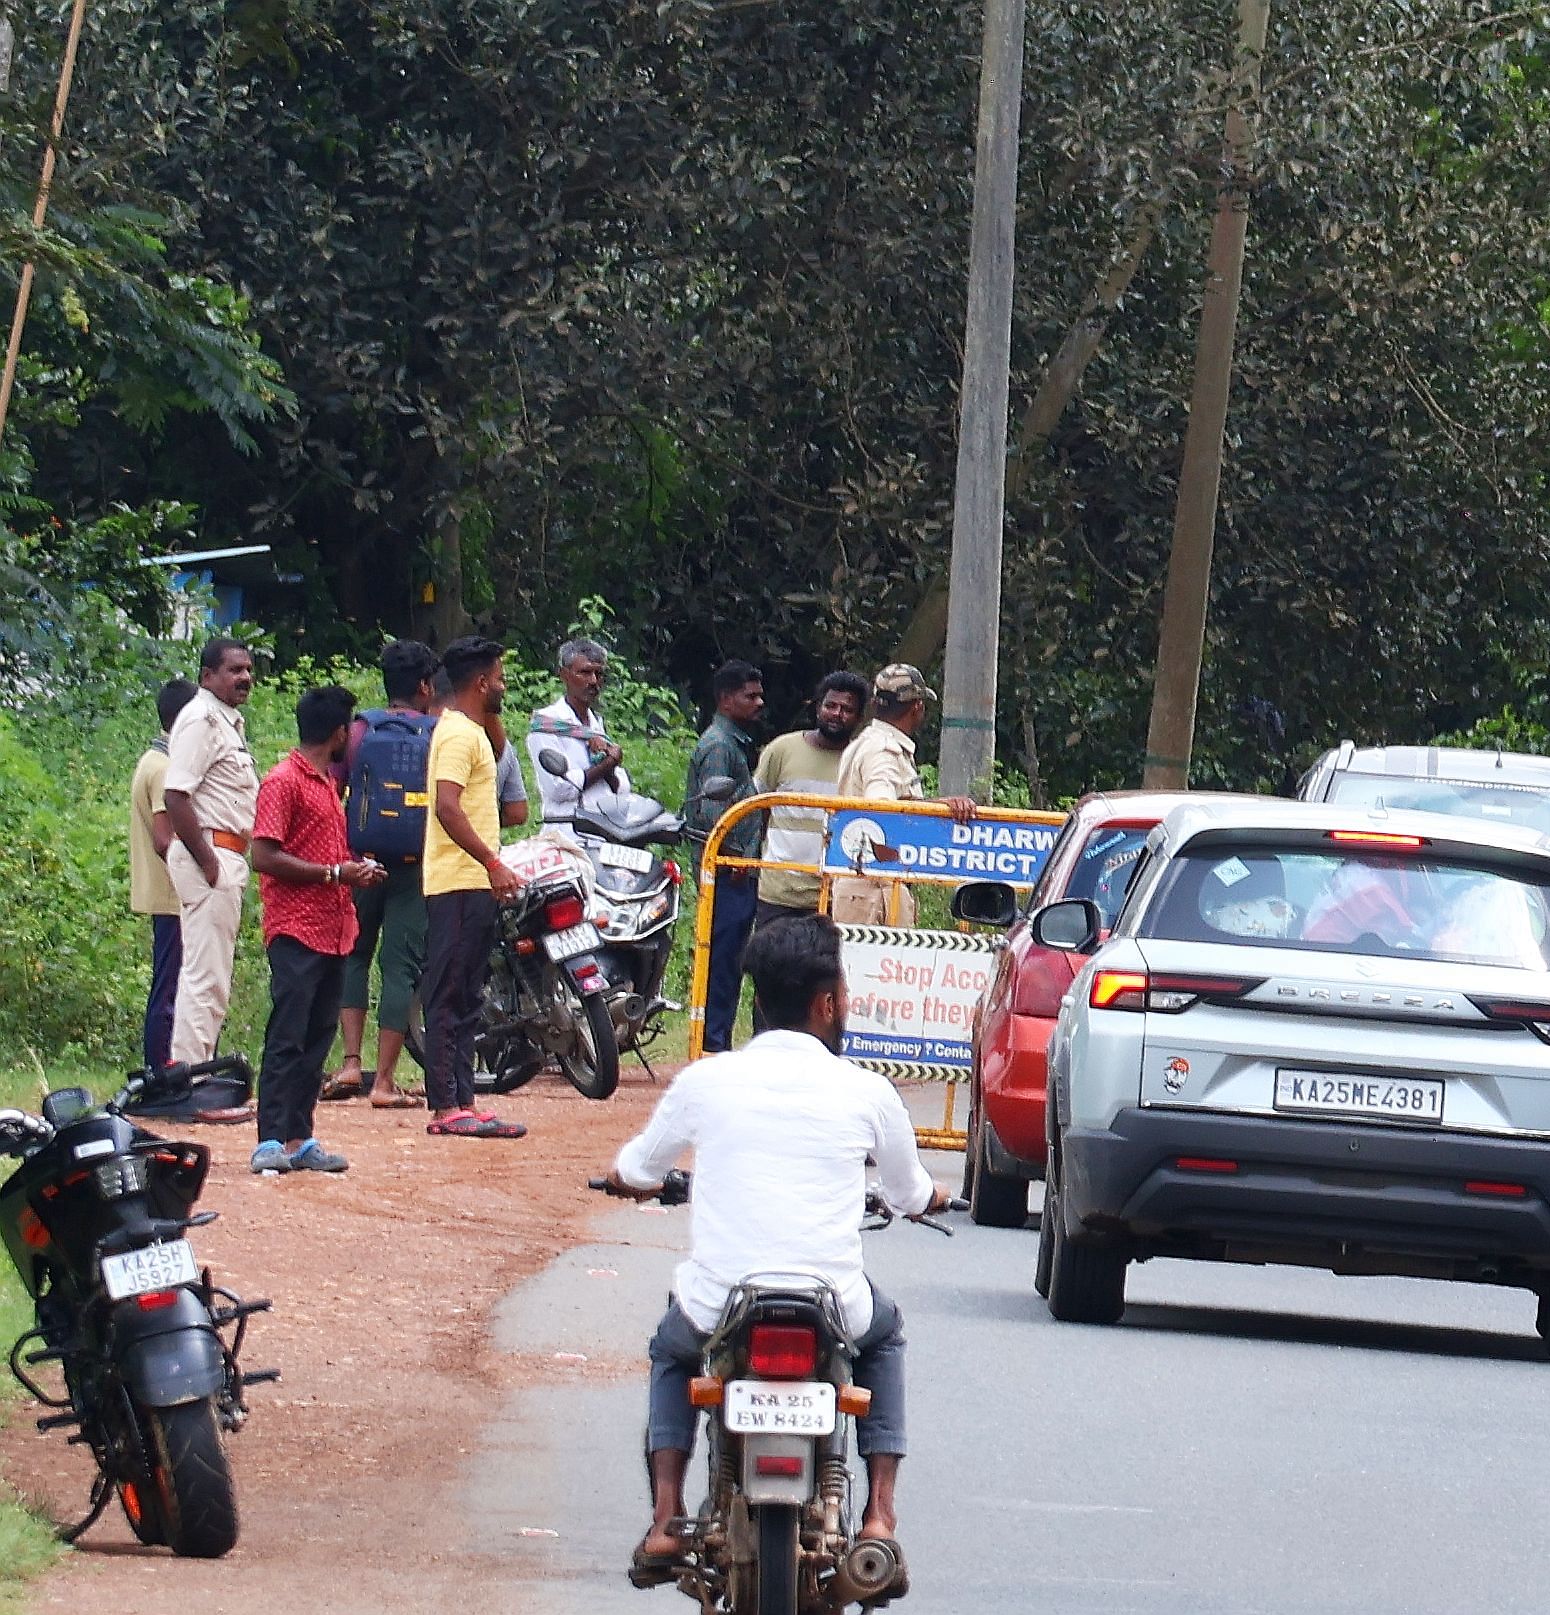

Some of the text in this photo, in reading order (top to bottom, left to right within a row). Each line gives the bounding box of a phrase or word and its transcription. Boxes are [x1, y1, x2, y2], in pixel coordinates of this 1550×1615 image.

[898, 844, 1037, 875] DISTRICT
[880, 957, 933, 992] Stop
[850, 992, 914, 1020] efore
[1278, 985, 1454, 1009] BREZZA
[923, 996, 976, 1031] they
[852, 1036, 921, 1056] Emergency
[1293, 1078, 1437, 1111] KA25ME4381
[122, 1244, 183, 1273] KA25H
[129, 1263, 184, 1291] J5927
[750, 1393, 814, 1408] KA 25
[736, 1411, 825, 1429] EW 8424
